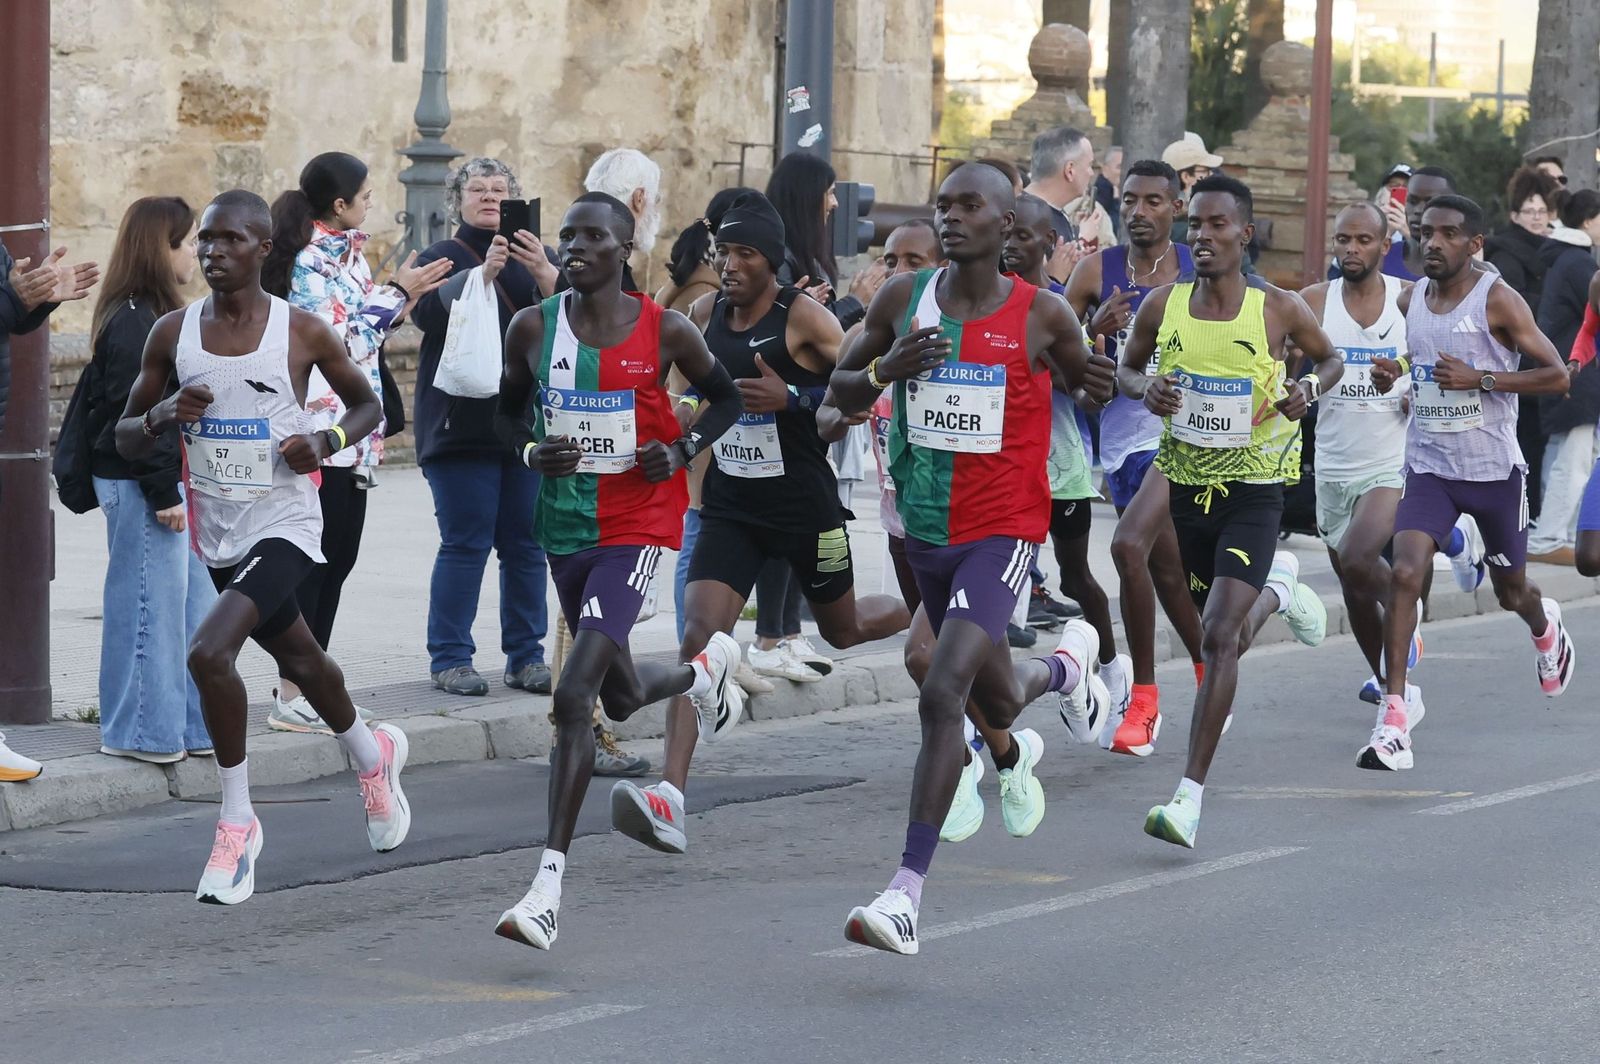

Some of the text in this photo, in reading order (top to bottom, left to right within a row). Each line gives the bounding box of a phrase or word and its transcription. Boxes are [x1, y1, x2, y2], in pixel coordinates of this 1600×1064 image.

[938, 367, 993, 382] ZURICH
[1360, 372, 1364, 380] 3
[1196, 380, 1242, 392] ZURICH
[1440, 388, 1445, 398] 4
[569, 396, 622, 408] ZURICH
[946, 394, 960, 406] 42
[1202, 402, 1214, 412] 38
[1416, 404, 1481, 418] GEBRETSADIK
[738, 413, 764, 422] ICH
[924, 409, 982, 432] PACER
[1187, 412, 1231, 432] ADISU
[206, 424, 258, 435] ZURICH
[578, 420, 591, 432] 41
[736, 432, 741, 442] 2
[566, 436, 614, 454] ACER
[216, 448, 229, 459] 57
[720, 442, 765, 461] KITATA
[206, 460, 252, 480] PACER
